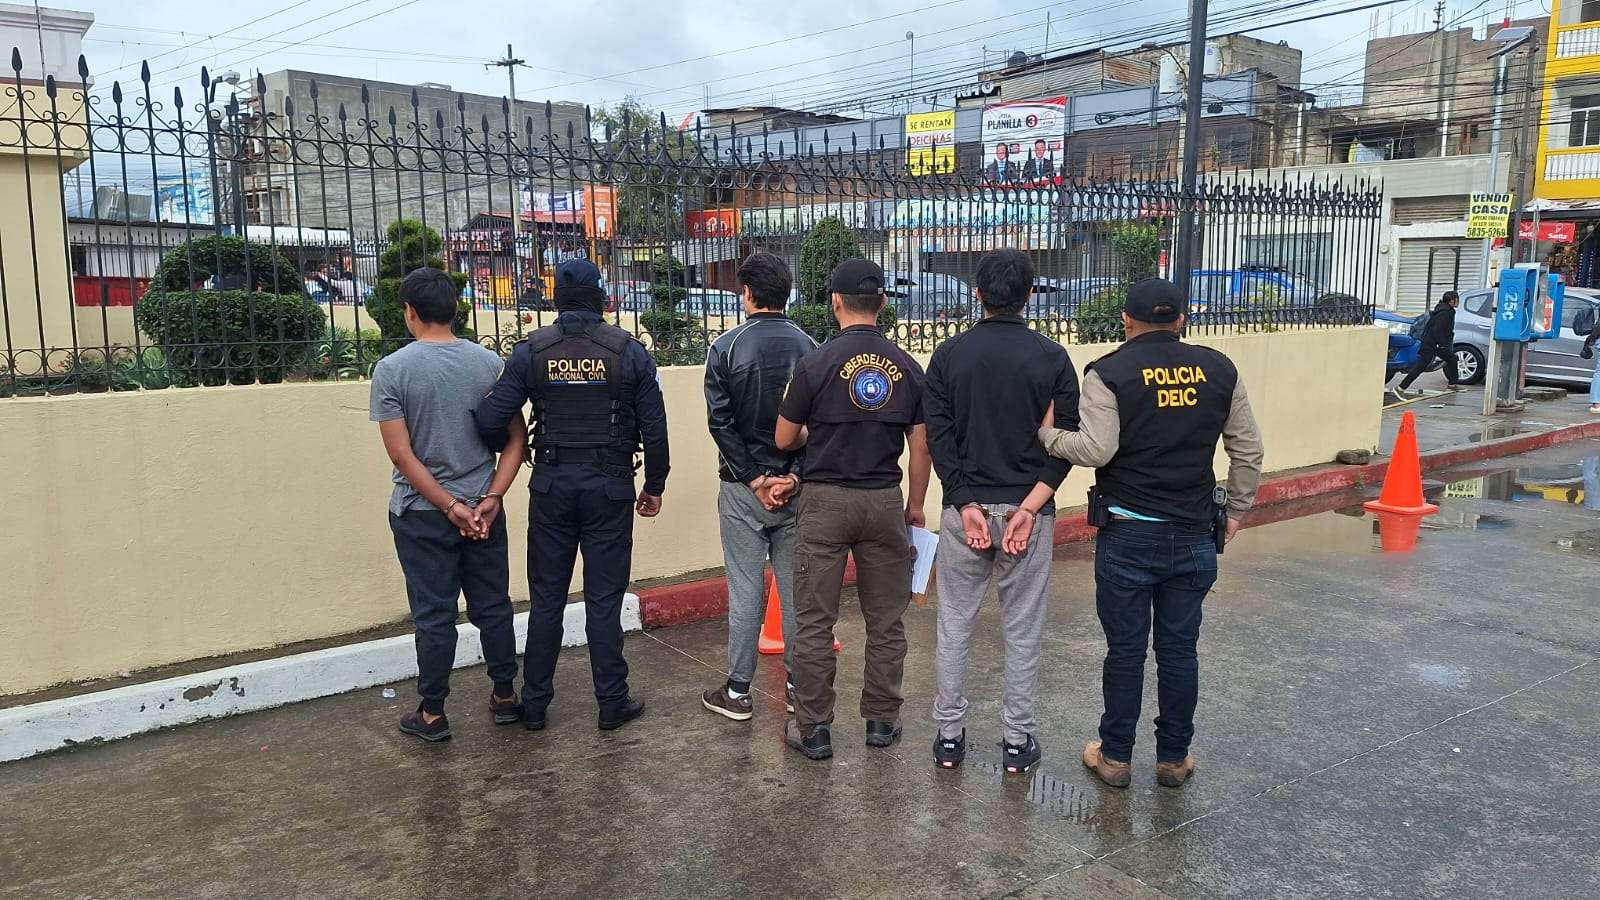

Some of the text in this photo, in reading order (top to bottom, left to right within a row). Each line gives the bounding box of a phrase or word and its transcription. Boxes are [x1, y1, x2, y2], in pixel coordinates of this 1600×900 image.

[910, 118, 952, 130] SE RENTAN
[987, 118, 1022, 130] PLANILLA
[1027, 115, 1037, 127] 3
[910, 133, 952, 145] OFICINAS
[1472, 193, 1509, 203] VENDO
[1472, 204, 1508, 215] CASA
[547, 358, 606, 372] POLICIA
[840, 353, 903, 382] CIBERDELITOS
[548, 371, 607, 381] NACIONAL CIVIL
[1142, 366, 1207, 386] POLICIA
[1157, 387, 1198, 408] DEIC
